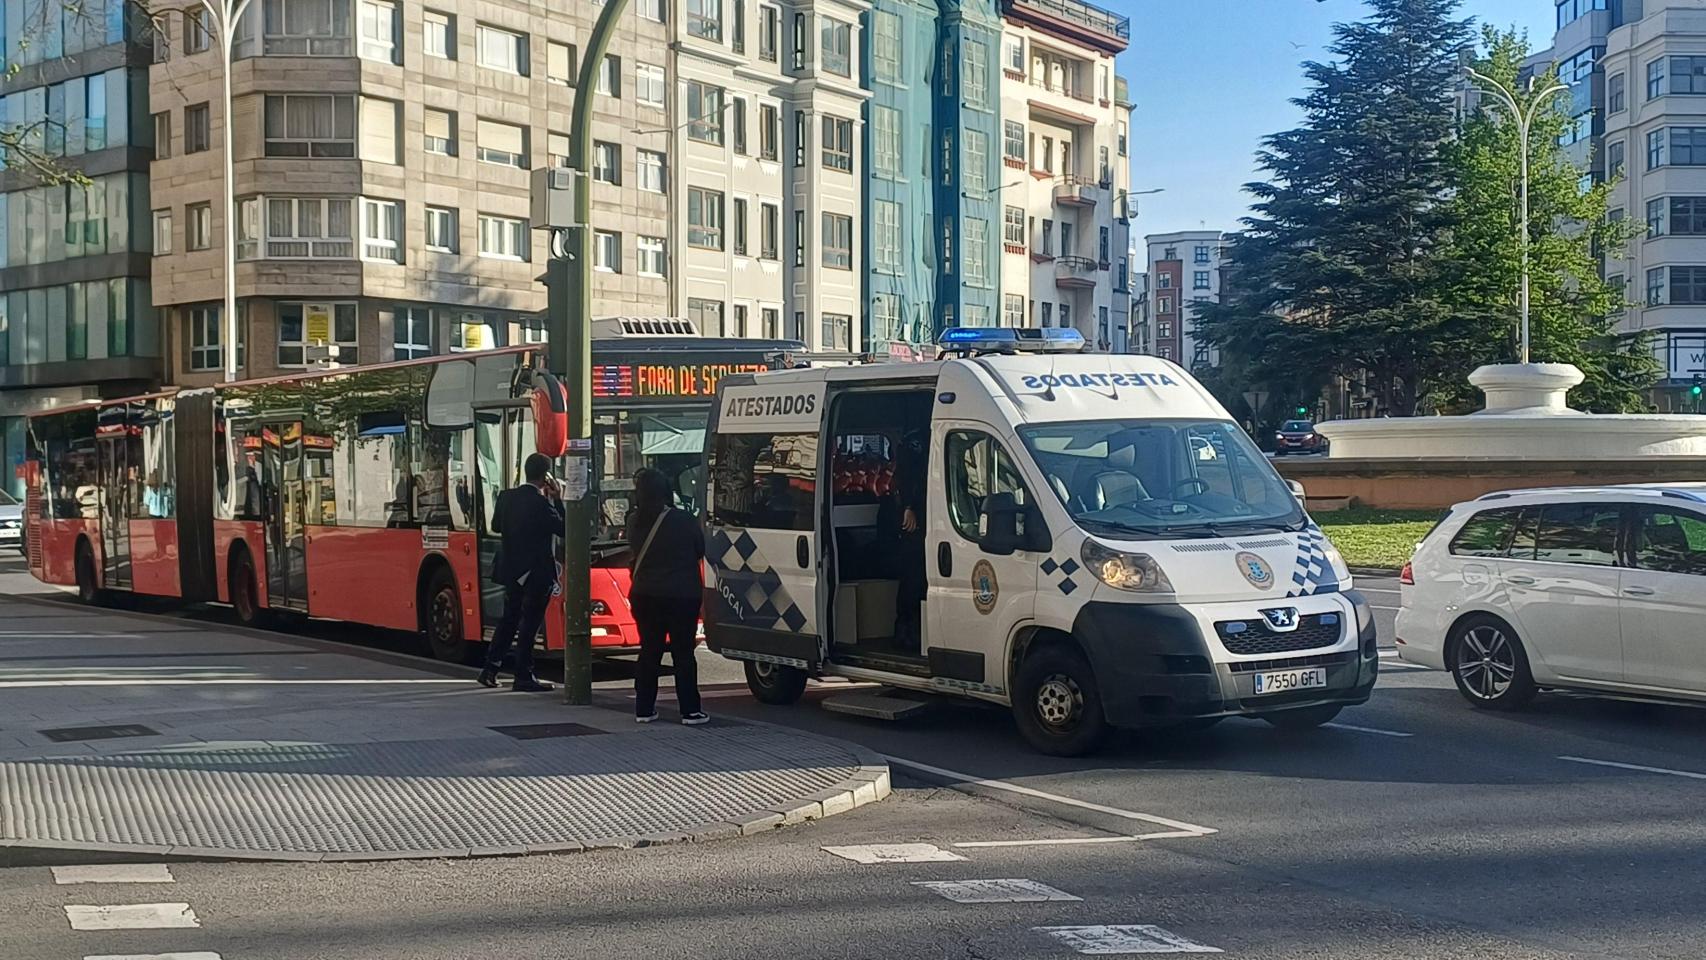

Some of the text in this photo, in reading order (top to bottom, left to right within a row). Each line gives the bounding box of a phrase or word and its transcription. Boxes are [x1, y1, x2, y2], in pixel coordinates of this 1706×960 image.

[638, 366, 675, 395] FORA
[680, 365, 697, 395] DE
[726, 394, 816, 417] ATESTADOS
[719, 578, 744, 620] LOCAL
[1267, 673, 1297, 690] 7550
[1301, 671, 1323, 686] GFL
